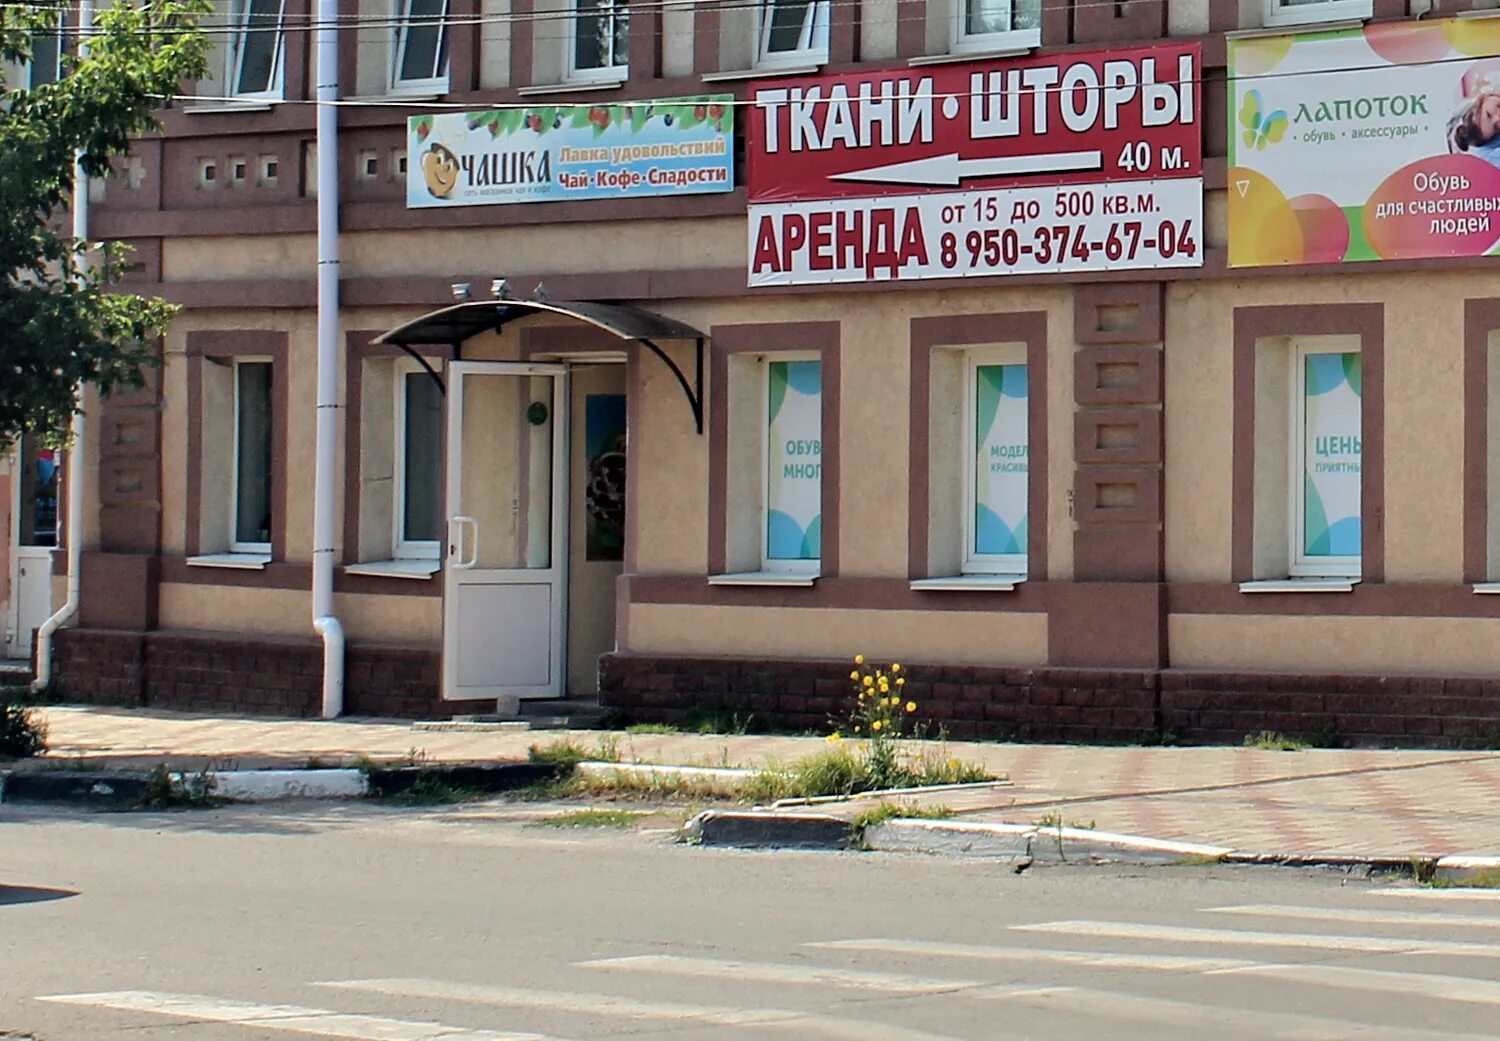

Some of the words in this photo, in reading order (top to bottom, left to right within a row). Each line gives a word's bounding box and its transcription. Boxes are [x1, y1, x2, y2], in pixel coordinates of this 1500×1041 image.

[755, 77, 933, 153] ТКАНИ
[970, 55, 1194, 139] ШТОРЫ
[1303, 129, 1335, 144] обувь
[1351, 124, 1418, 140] аксессуары
[560, 147, 608, 162] Лавка
[612, 137, 724, 164] удовольствий
[1118, 142, 1151, 172] 40
[1161, 146, 1190, 170] м.
[1413, 172, 1471, 195] Обувь
[941, 205, 965, 223] от
[973, 197, 997, 222] 15
[1010, 200, 1040, 224] до
[1055, 191, 1094, 217] 500
[1103, 194, 1160, 215] кв.м.
[1376, 202, 1404, 219] для
[1430, 212, 1490, 235] людей
[752, 206, 929, 280] АРЕНДА
[940, 232, 957, 269] 8
[966, 220, 1196, 268] 950-374-67-04
